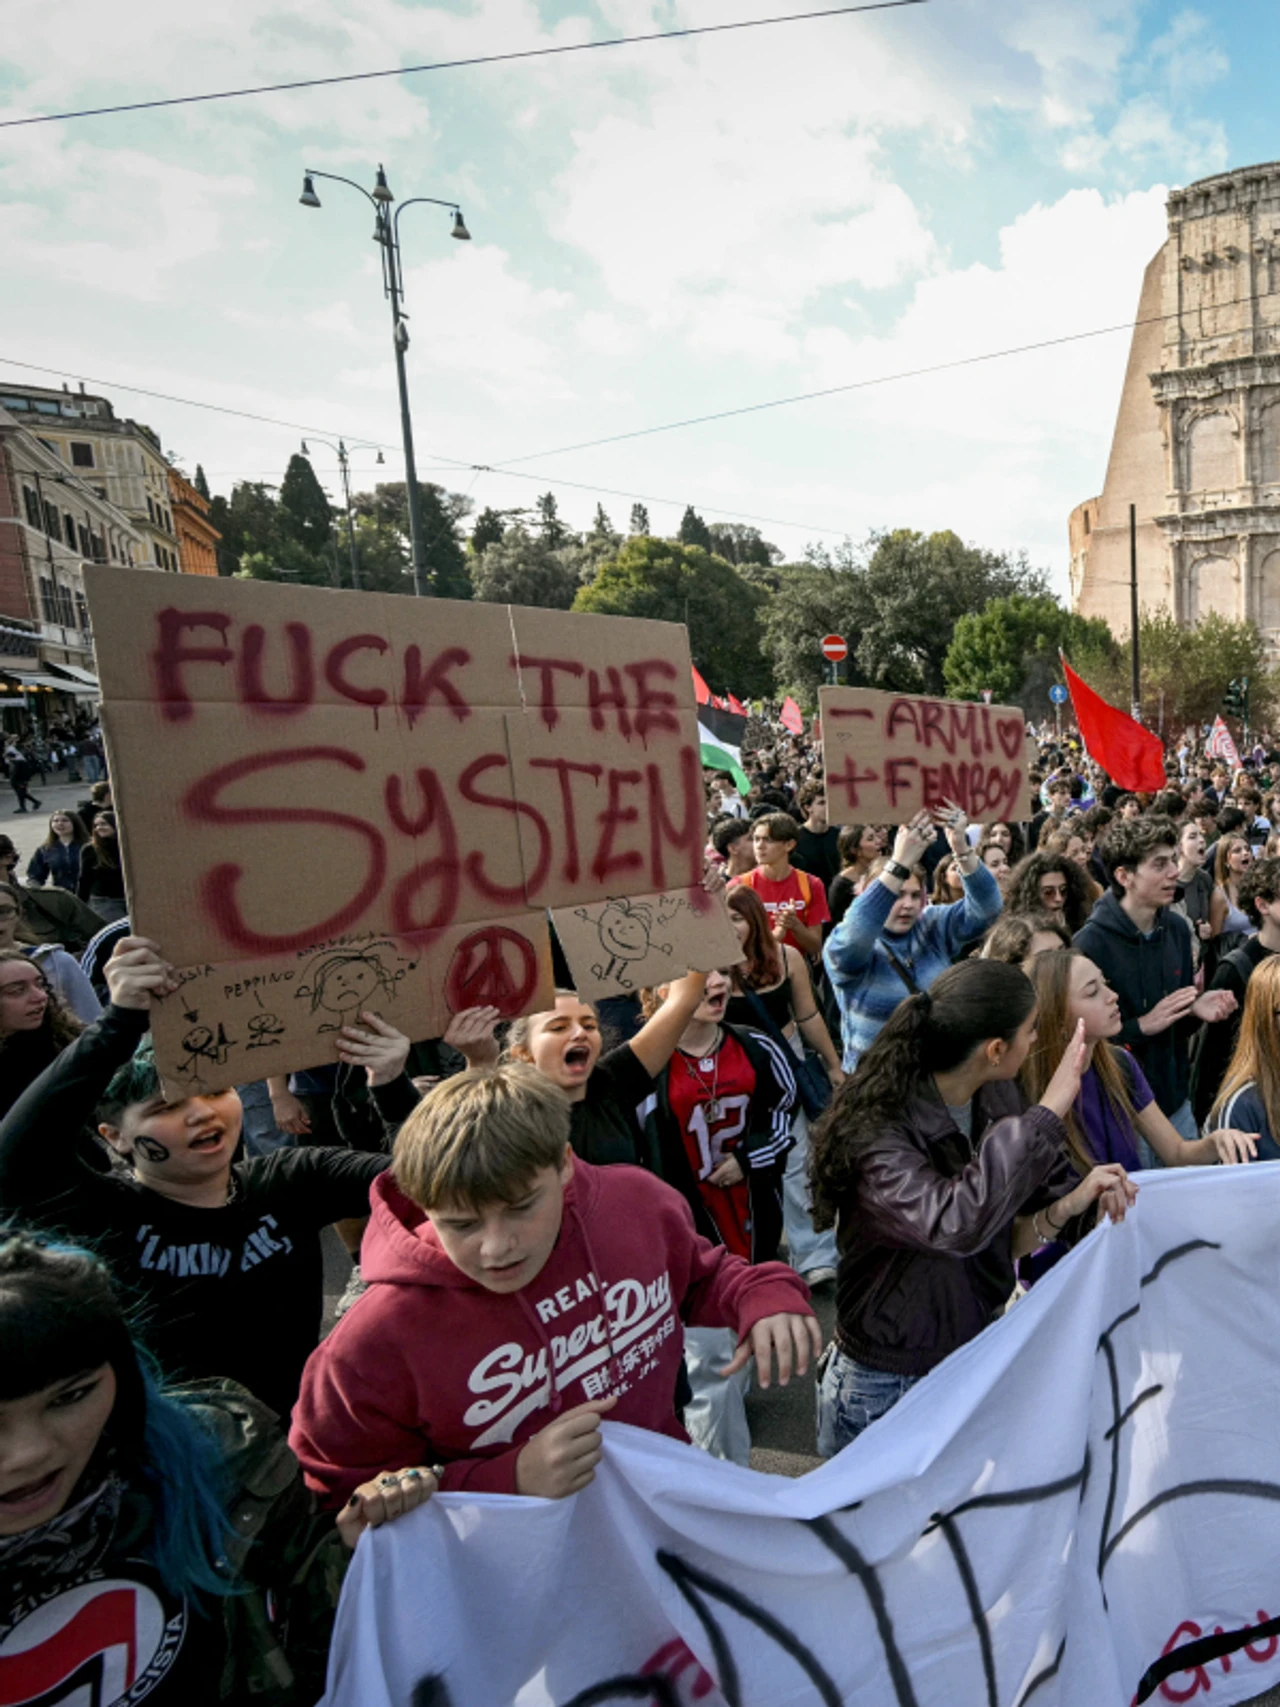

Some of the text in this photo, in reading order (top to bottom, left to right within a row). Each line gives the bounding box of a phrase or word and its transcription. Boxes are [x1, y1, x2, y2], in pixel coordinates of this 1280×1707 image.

[154, 607, 680, 738] FUCK THE
[885, 697, 993, 757] ARMI
[687, 1094, 751, 1183] 12
[536, 1271, 609, 1324] REAL
